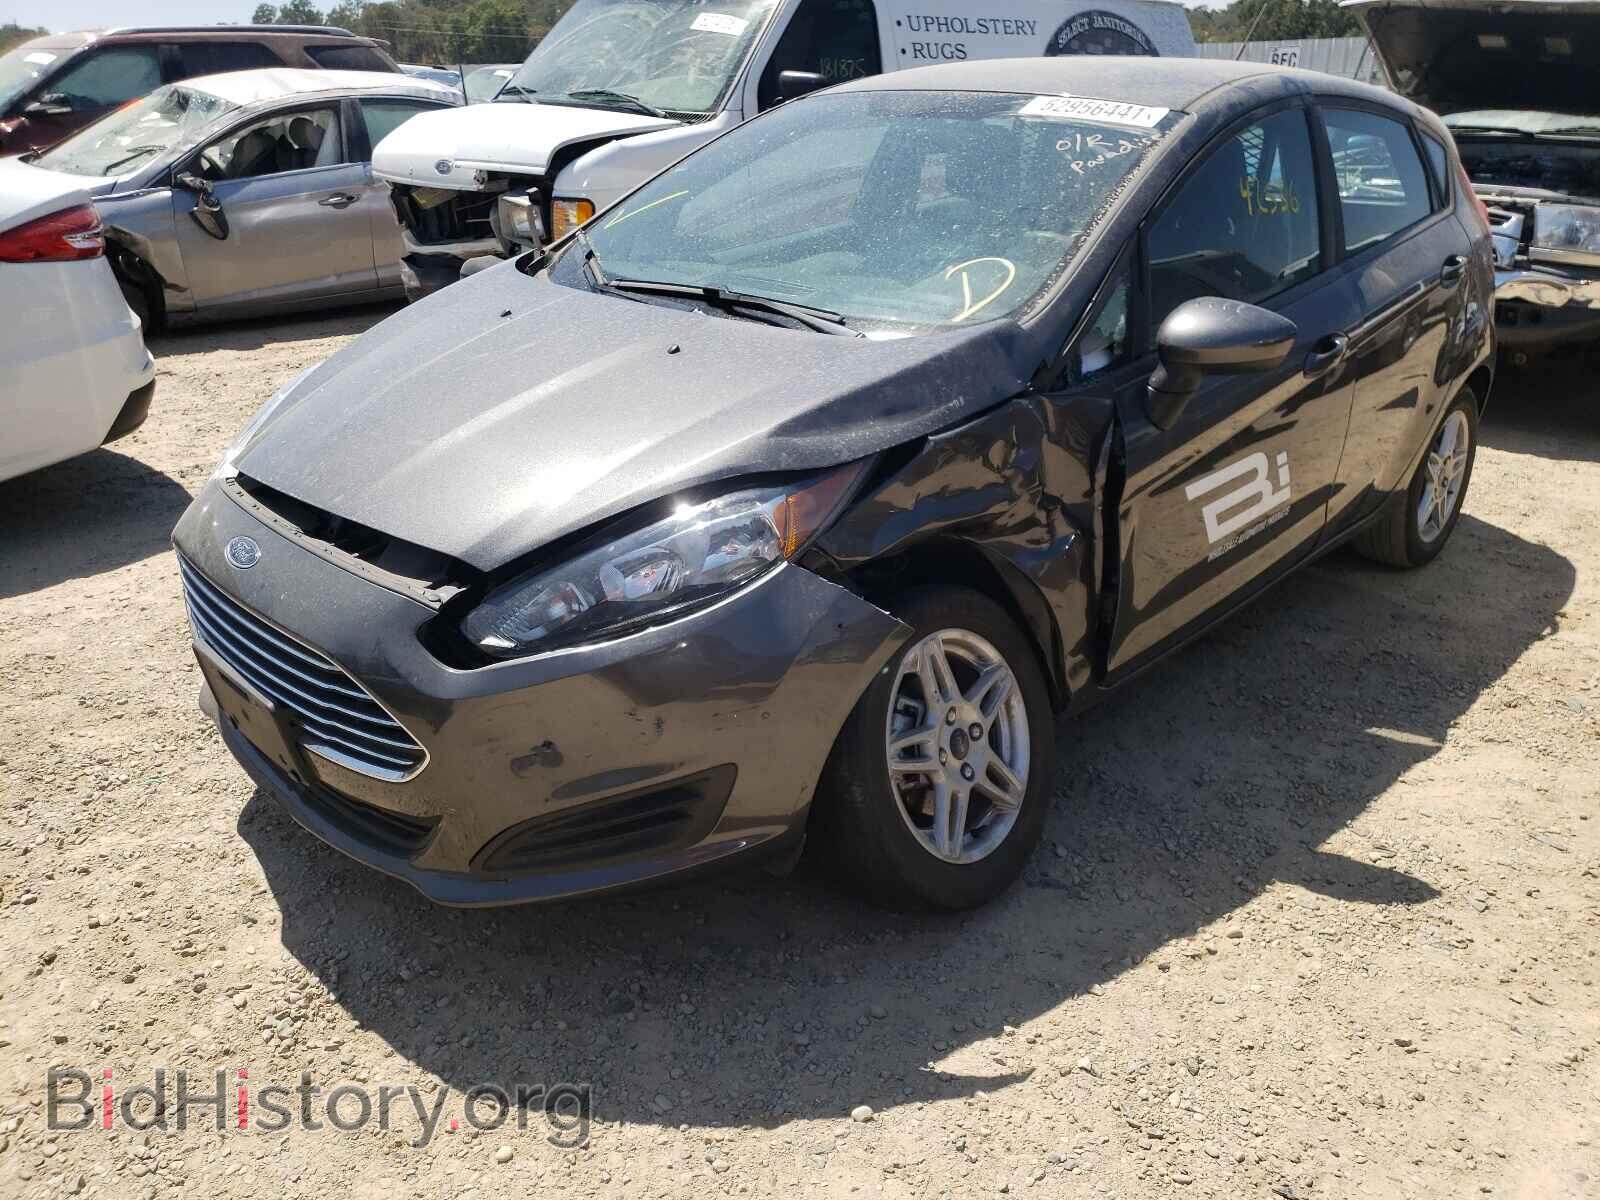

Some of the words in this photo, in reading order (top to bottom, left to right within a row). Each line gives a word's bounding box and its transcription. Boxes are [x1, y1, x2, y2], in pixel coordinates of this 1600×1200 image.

[907, 15, 1037, 36] UPHOLSTERY
[1058, 17, 1089, 48] SELECT
[911, 42, 968, 60] RUGS
[944, 257, 1016, 322] D
